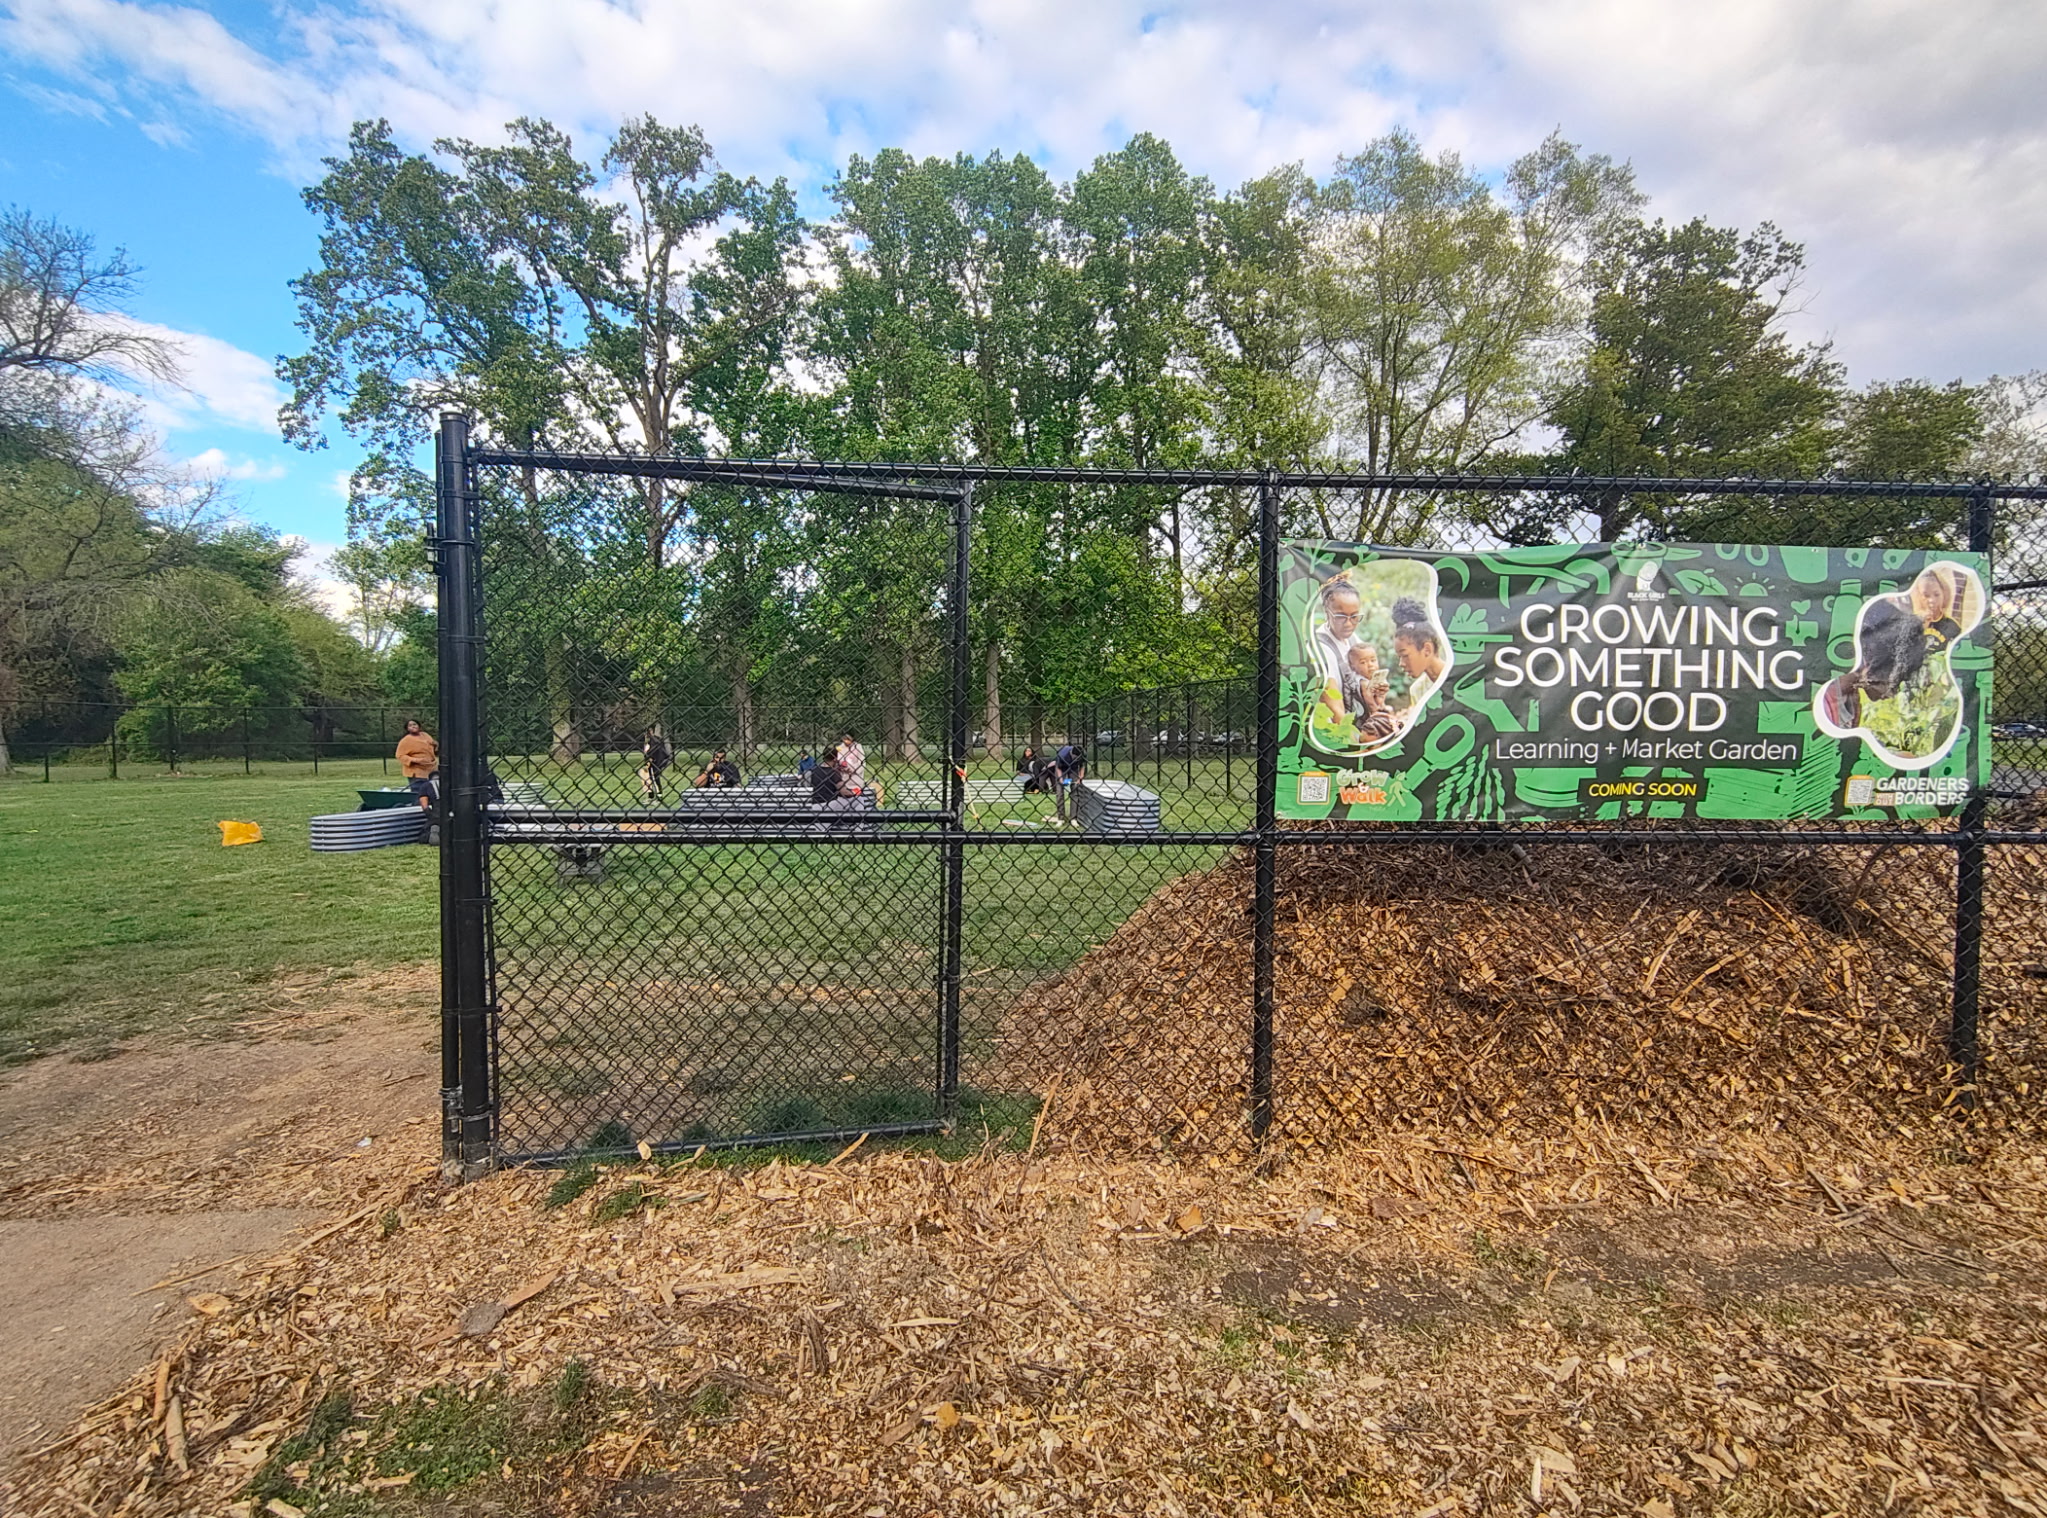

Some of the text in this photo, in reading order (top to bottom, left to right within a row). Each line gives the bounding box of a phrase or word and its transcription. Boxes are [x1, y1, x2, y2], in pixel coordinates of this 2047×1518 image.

[1520, 603, 1779, 646] GROWING
[1494, 647, 1804, 690] SOMETHING
[1570, 690, 1727, 732] GOOD
[1496, 738, 1797, 763] Learning + Market Garden
[1588, 782, 1697, 797] COMING SOON
[1876, 777, 1970, 791] GARDENERS
[1339, 787, 1387, 804] Walk
[1895, 792, 1966, 805] BORDERS
